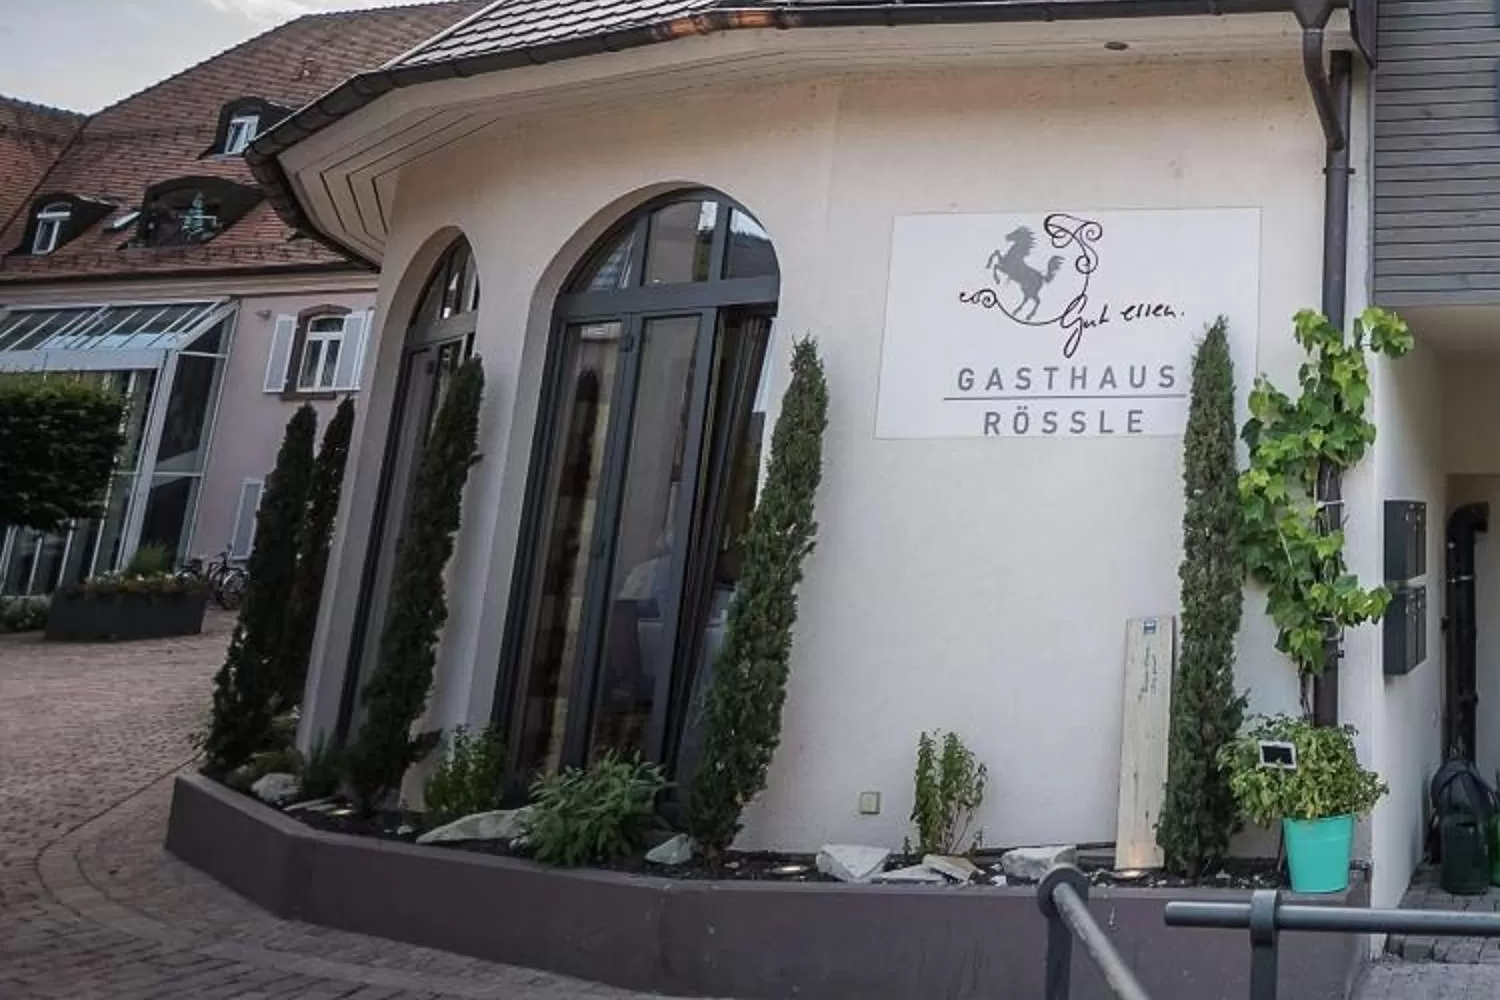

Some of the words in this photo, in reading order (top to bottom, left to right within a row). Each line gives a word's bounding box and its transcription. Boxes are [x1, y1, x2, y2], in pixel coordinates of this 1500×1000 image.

[1059, 292, 1109, 359] Gut
[957, 365, 1175, 391] GASTHAUS
[983, 405, 1145, 435] RÖSSLE
